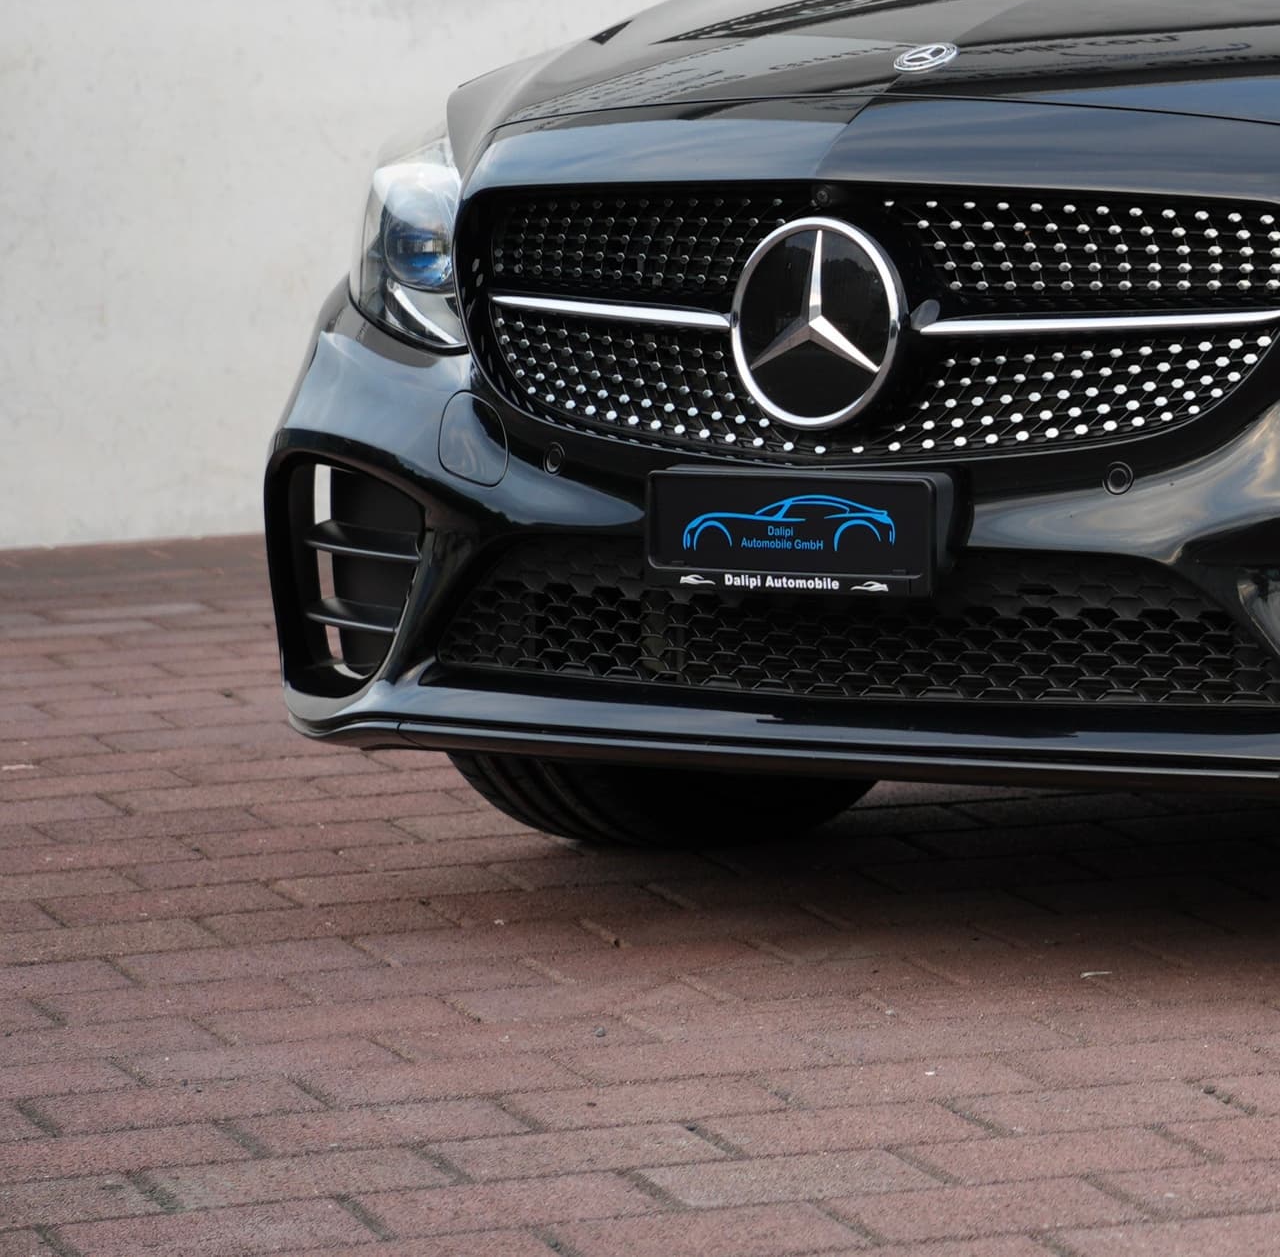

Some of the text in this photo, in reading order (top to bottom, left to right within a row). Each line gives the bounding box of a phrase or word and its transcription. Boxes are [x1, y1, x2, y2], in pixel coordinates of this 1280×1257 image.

[767, 525, 794, 538] Dalipi
[741, 537, 824, 550] Automobile GmbH
[724, 574, 840, 590] Dalipi Automobile
